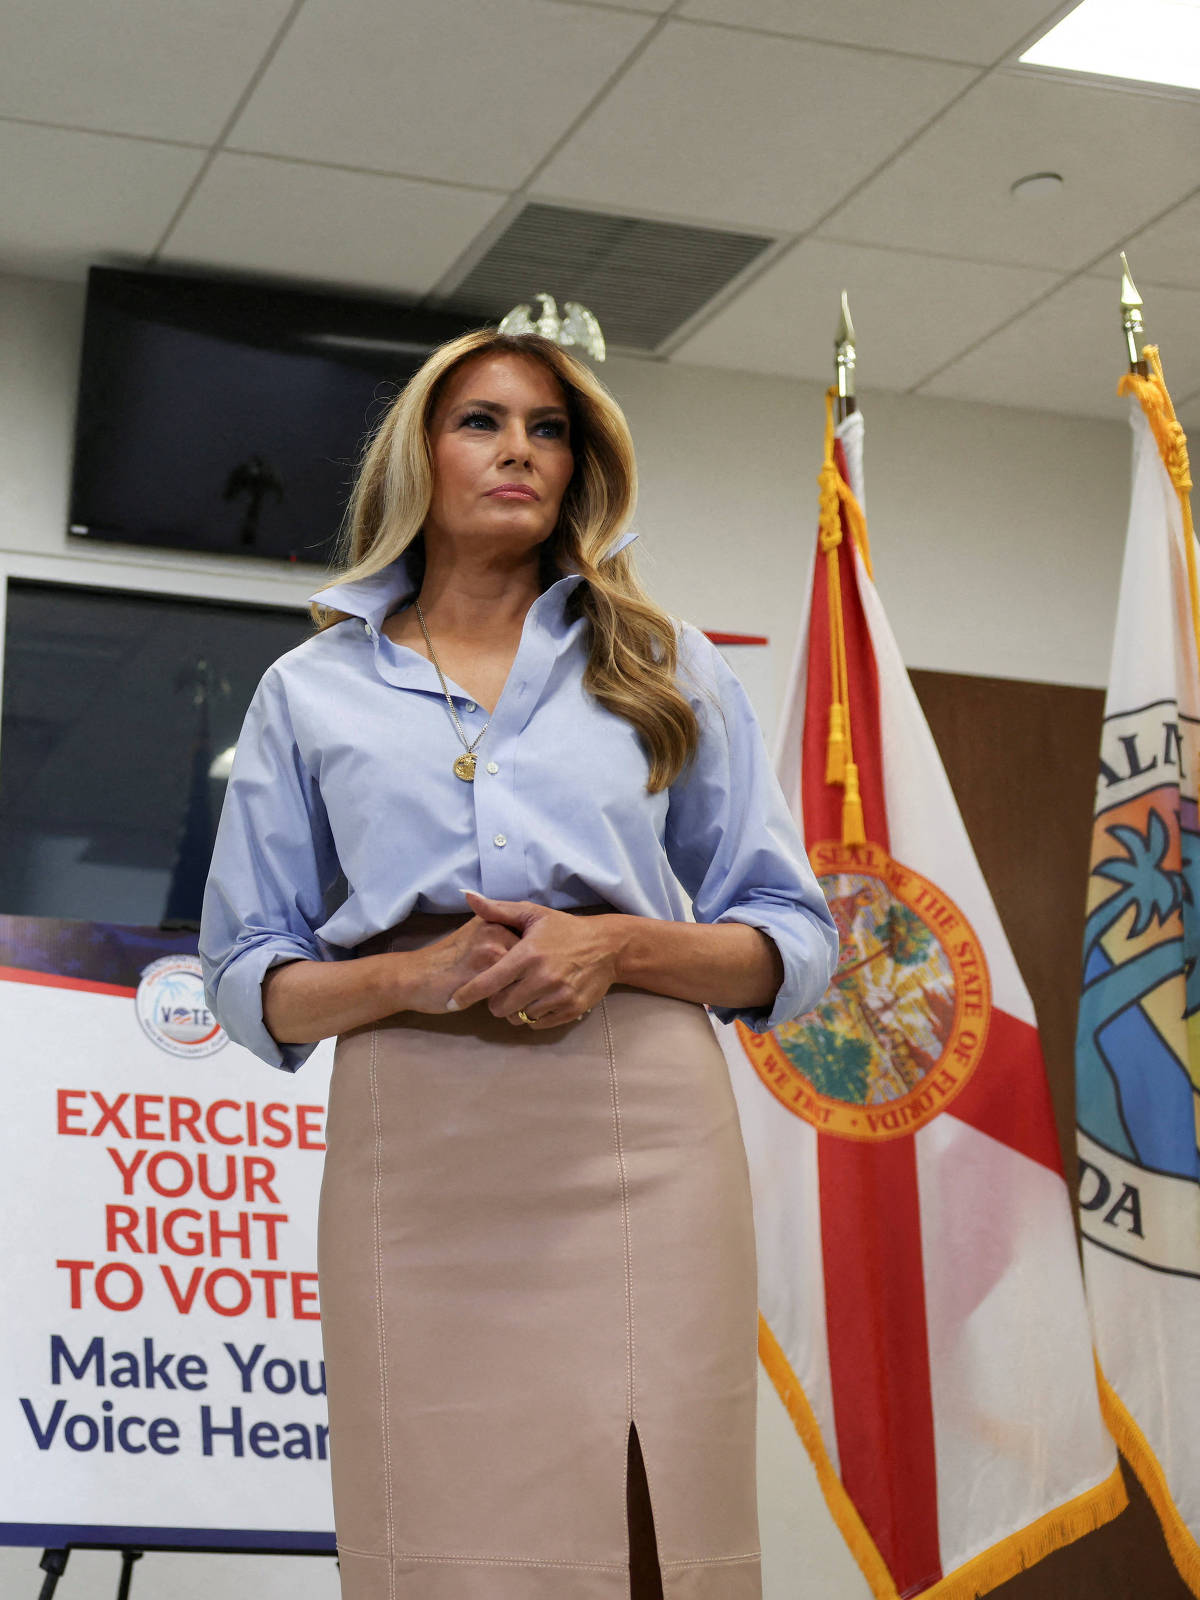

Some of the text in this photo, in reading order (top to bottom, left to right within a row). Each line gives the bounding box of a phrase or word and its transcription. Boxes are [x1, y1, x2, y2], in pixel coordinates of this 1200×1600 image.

[914, 887, 959, 934] THE
[956, 941, 984, 1018] STATE
[953, 1029, 978, 1068] OF
[56, 1088, 327, 1151] EXERCISE
[866, 1069, 958, 1133] FLORIDA
[106, 1147, 281, 1204] YOUR
[105, 1204, 289, 1261] RIGHT
[56, 1259, 321, 1321] TO VOTE
[50, 1335, 327, 1396] Make You
[19, 1397, 329, 1460] Voice Hear
